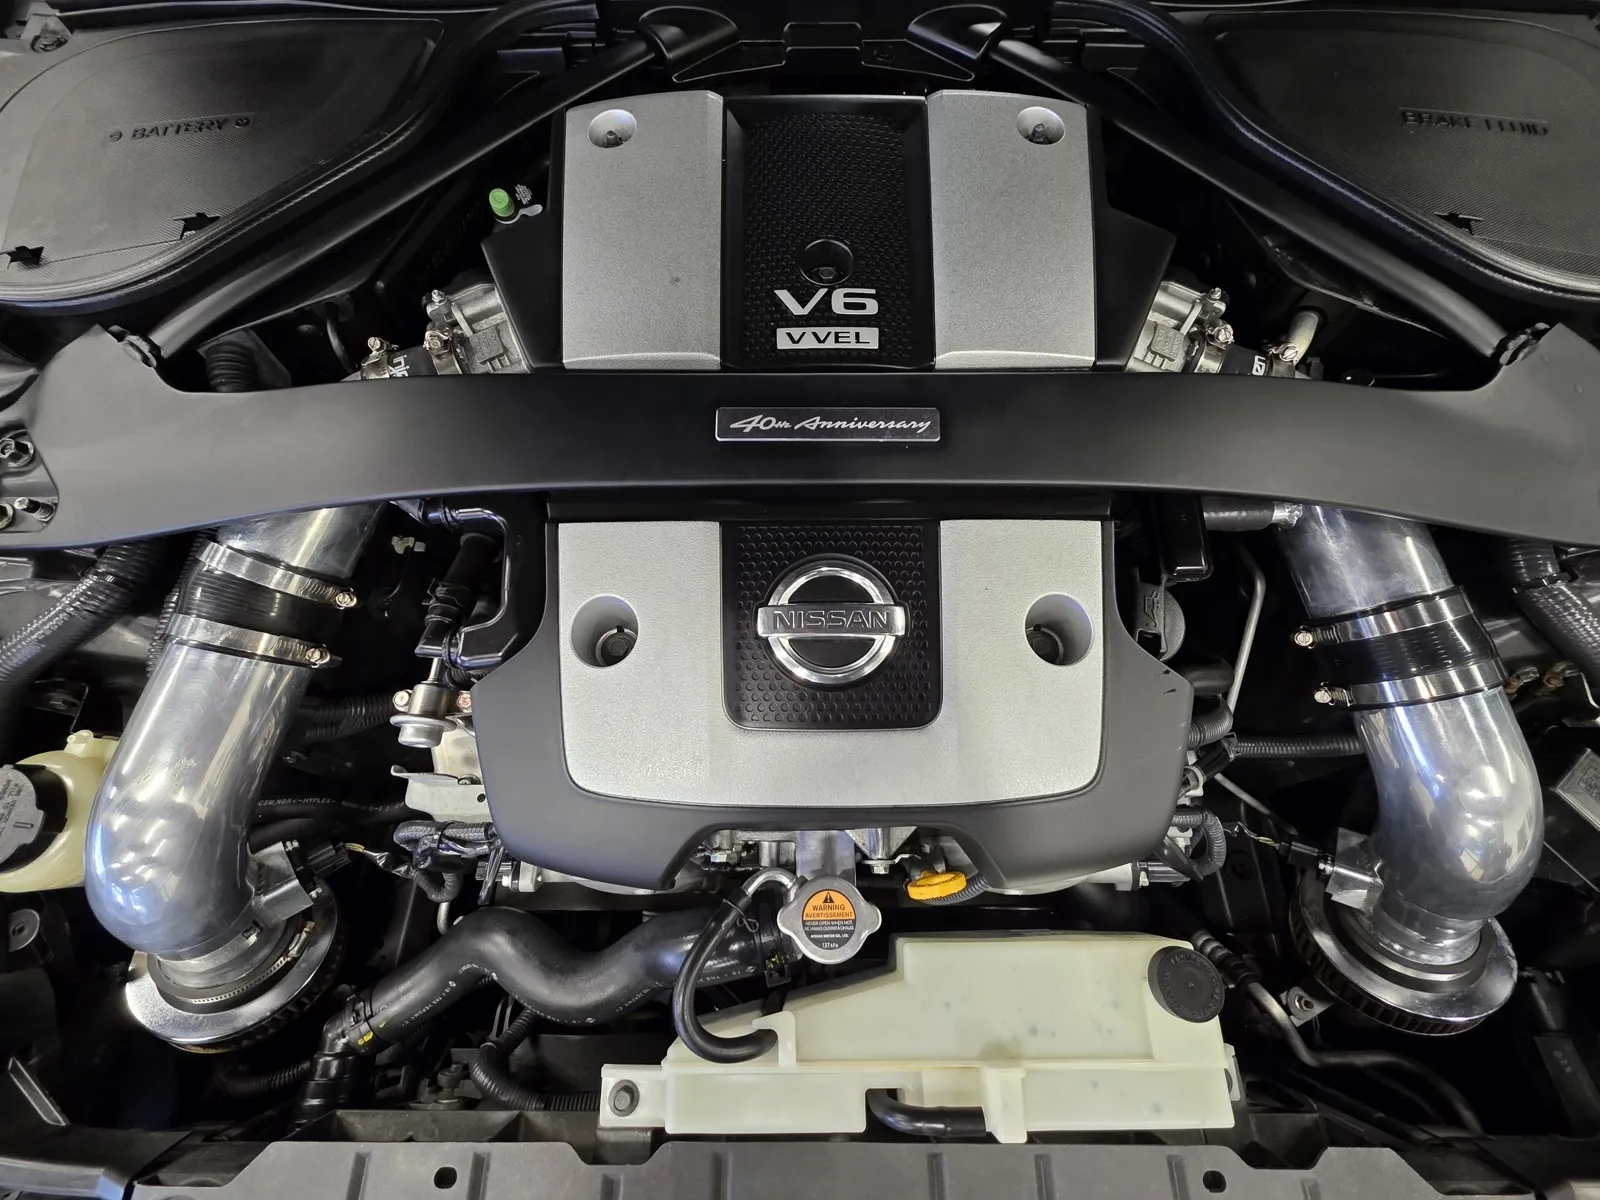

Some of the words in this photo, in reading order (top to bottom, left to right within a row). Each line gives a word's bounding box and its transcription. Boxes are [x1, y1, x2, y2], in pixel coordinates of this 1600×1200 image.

[131, 118, 229, 140] BATTERY
[1402, 110, 1473, 129] BRAKE
[774, 288, 879, 315] V6
[785, 331, 870, 344] VVEL
[729, 414, 792, 433] 40th
[794, 416, 932, 433] Anniversary
[773, 610, 890, 629] NISSAN
